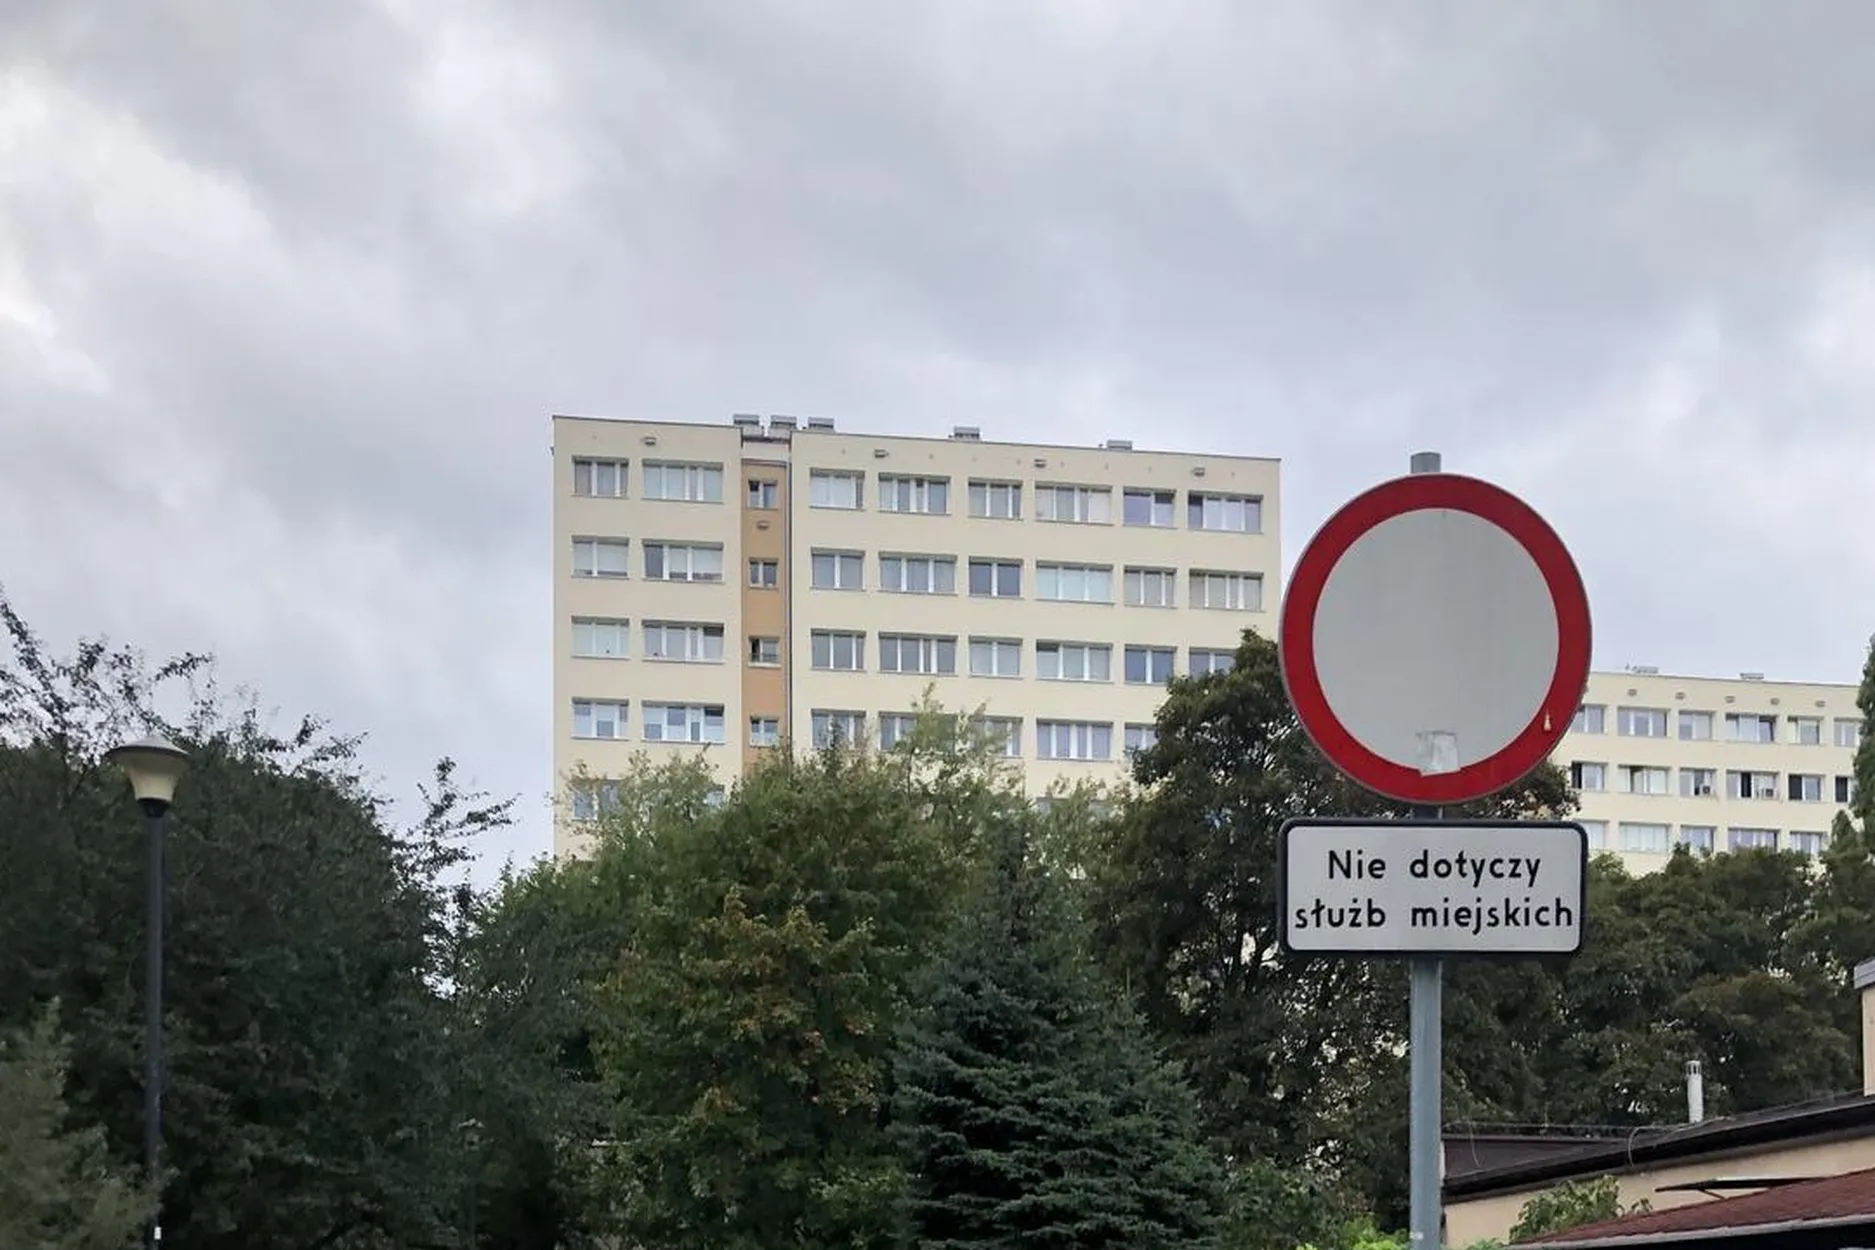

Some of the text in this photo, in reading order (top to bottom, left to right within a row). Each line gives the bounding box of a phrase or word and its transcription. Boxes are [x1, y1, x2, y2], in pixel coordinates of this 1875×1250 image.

[1328, 850, 1541, 888] Nie dotyczy
[1295, 898, 1573, 936] służb miejskich
